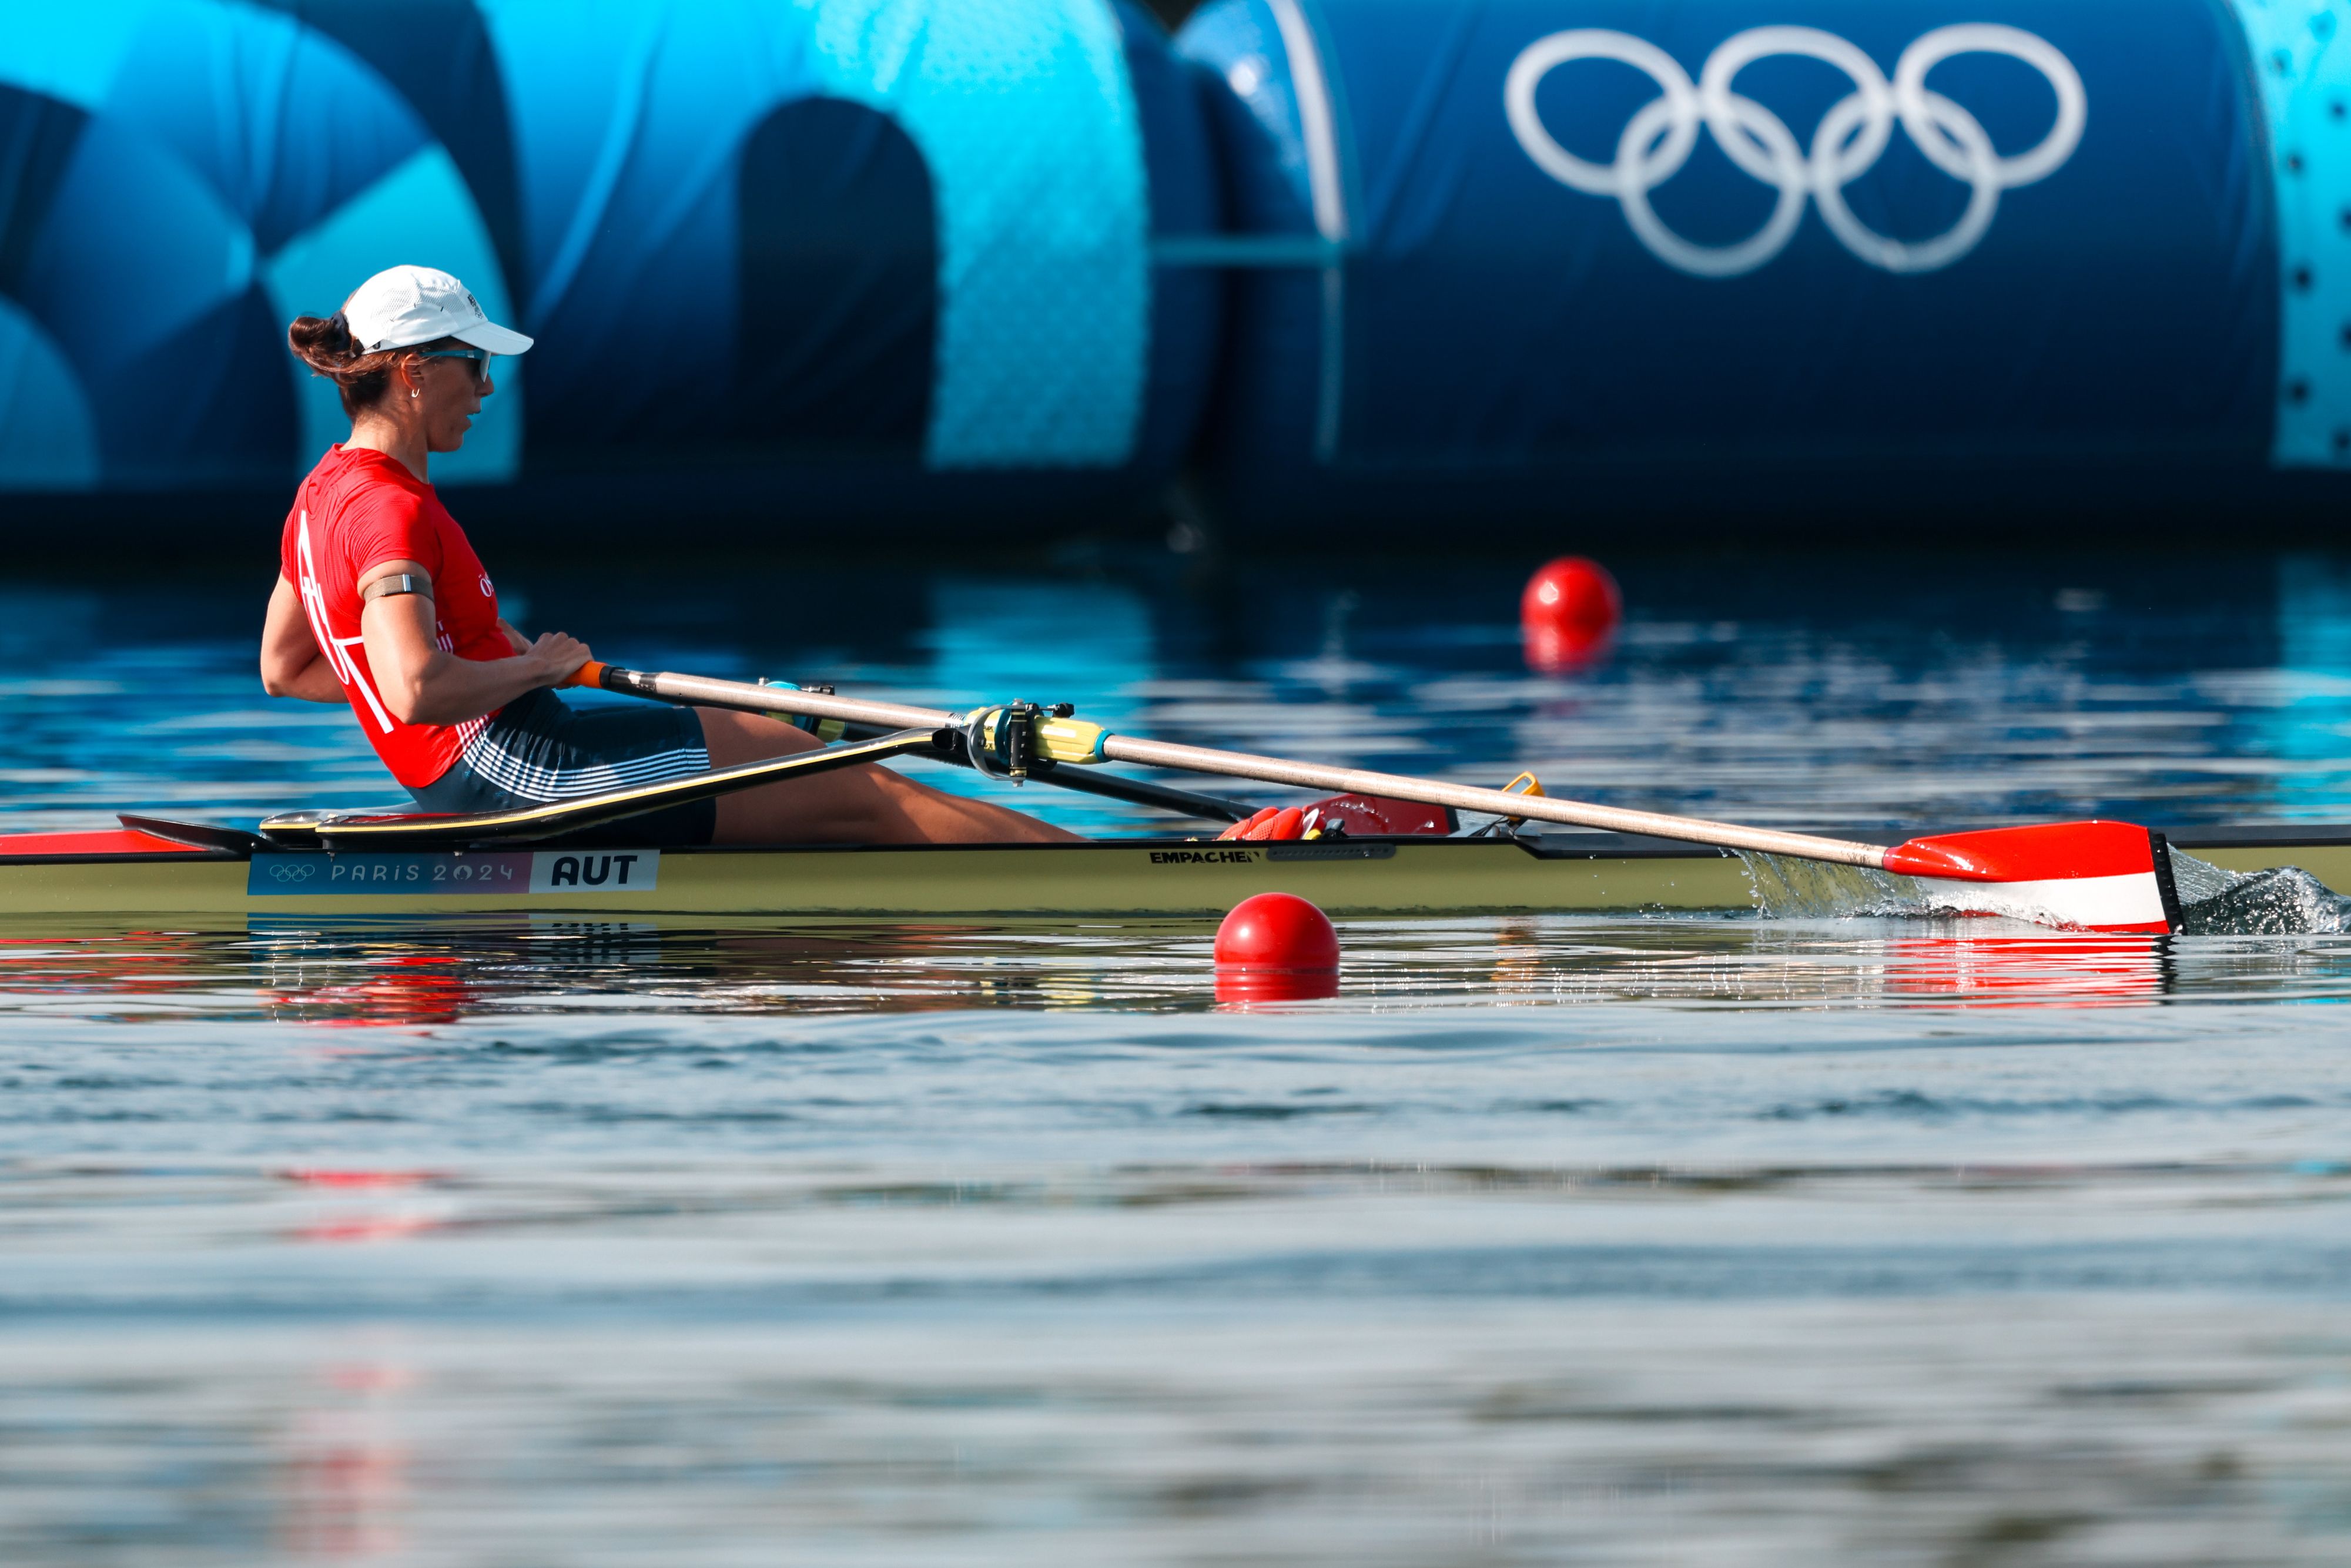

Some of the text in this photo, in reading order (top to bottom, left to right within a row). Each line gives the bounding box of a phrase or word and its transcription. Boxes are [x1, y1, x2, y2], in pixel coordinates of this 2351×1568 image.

[331, 865, 513, 881] PARIS 2024
[551, 855, 638, 886] AUT
